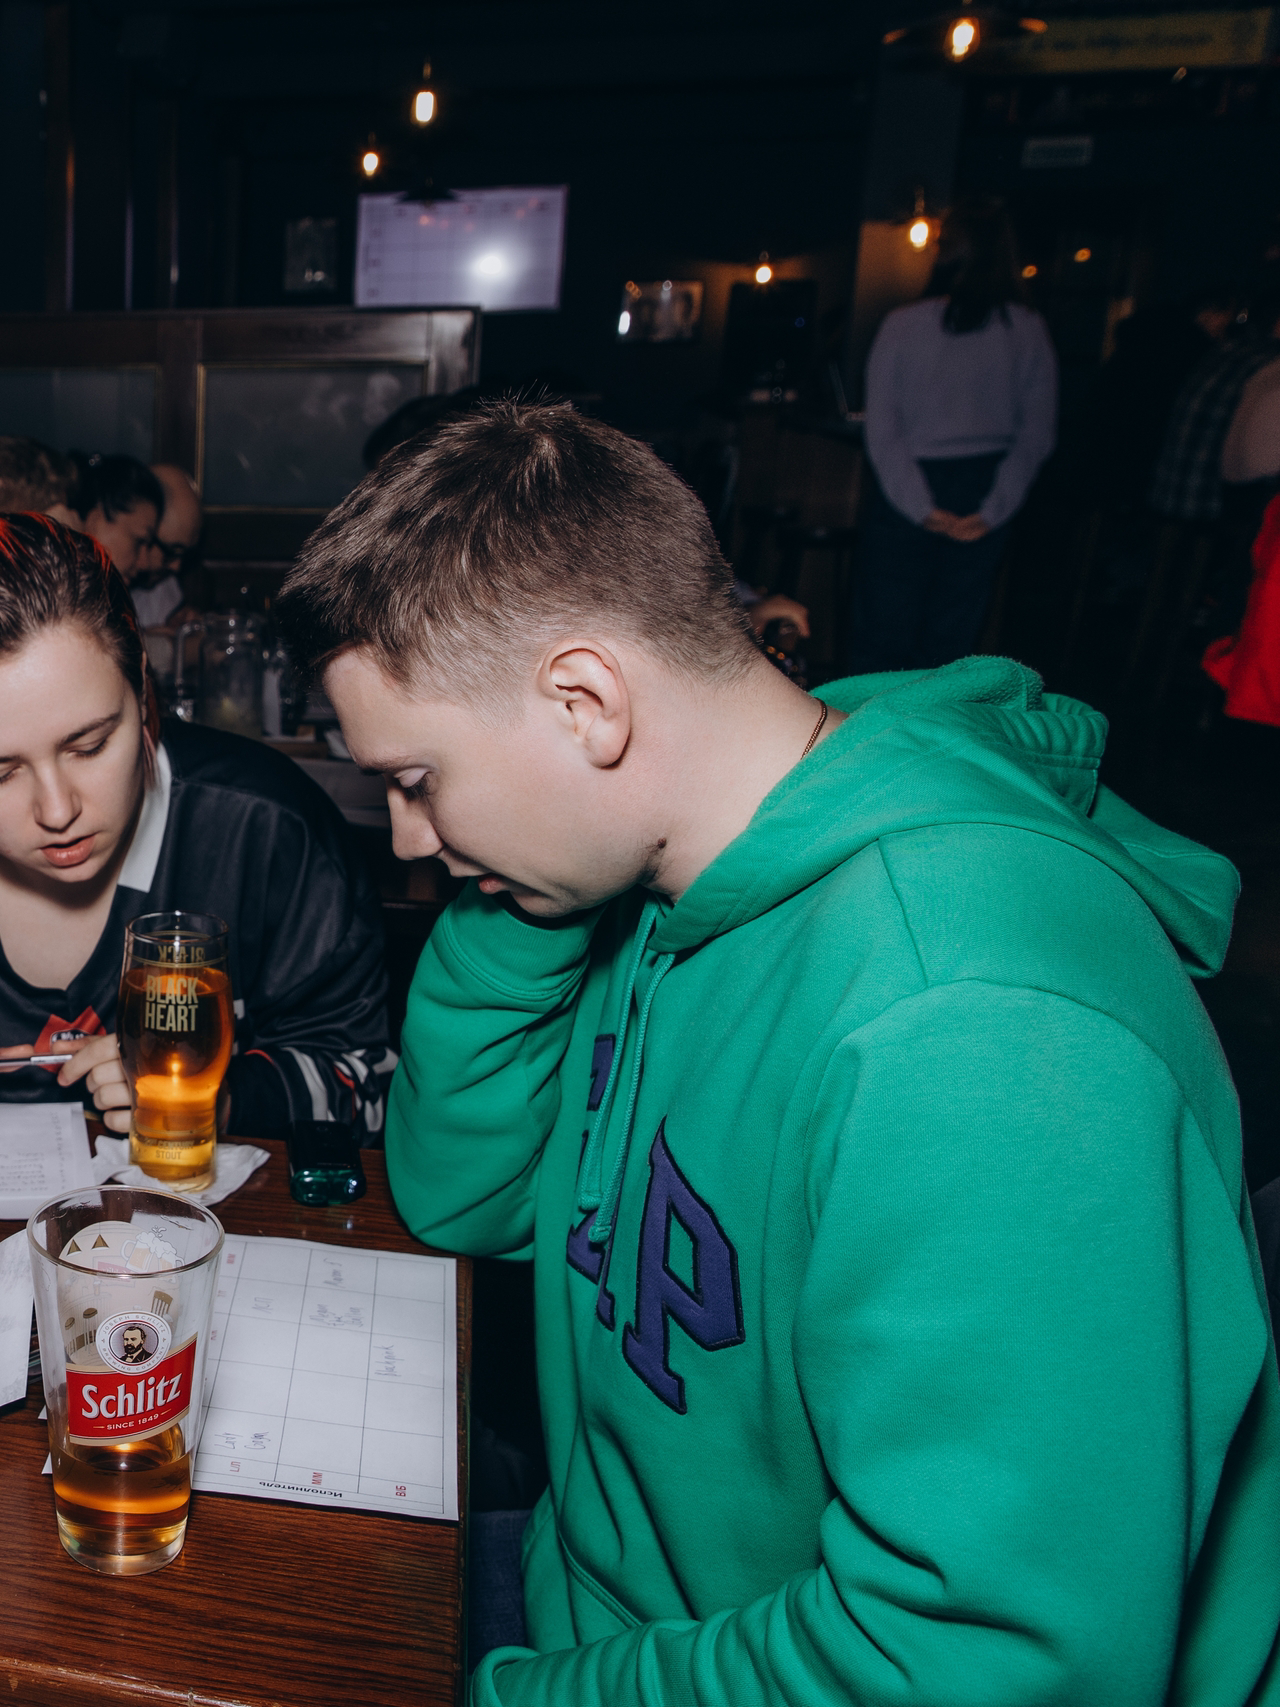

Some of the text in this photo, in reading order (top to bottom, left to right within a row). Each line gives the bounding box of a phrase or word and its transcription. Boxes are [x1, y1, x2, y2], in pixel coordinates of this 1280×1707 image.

[146, 975, 199, 1005] BLACK
[145, 1002, 198, 1032] HEART
[155, 1149, 182, 1160] STOUT
[103, 1315, 166, 1334] JOSEPH SCHLITZ
[102, 1346, 165, 1371] BREWING COMPANY
[81, 1373, 182, 1419] Schlitz
[106, 1414, 159, 1430] SINCE 1849
[259, 1481, 343, 1498] Исполнитель
